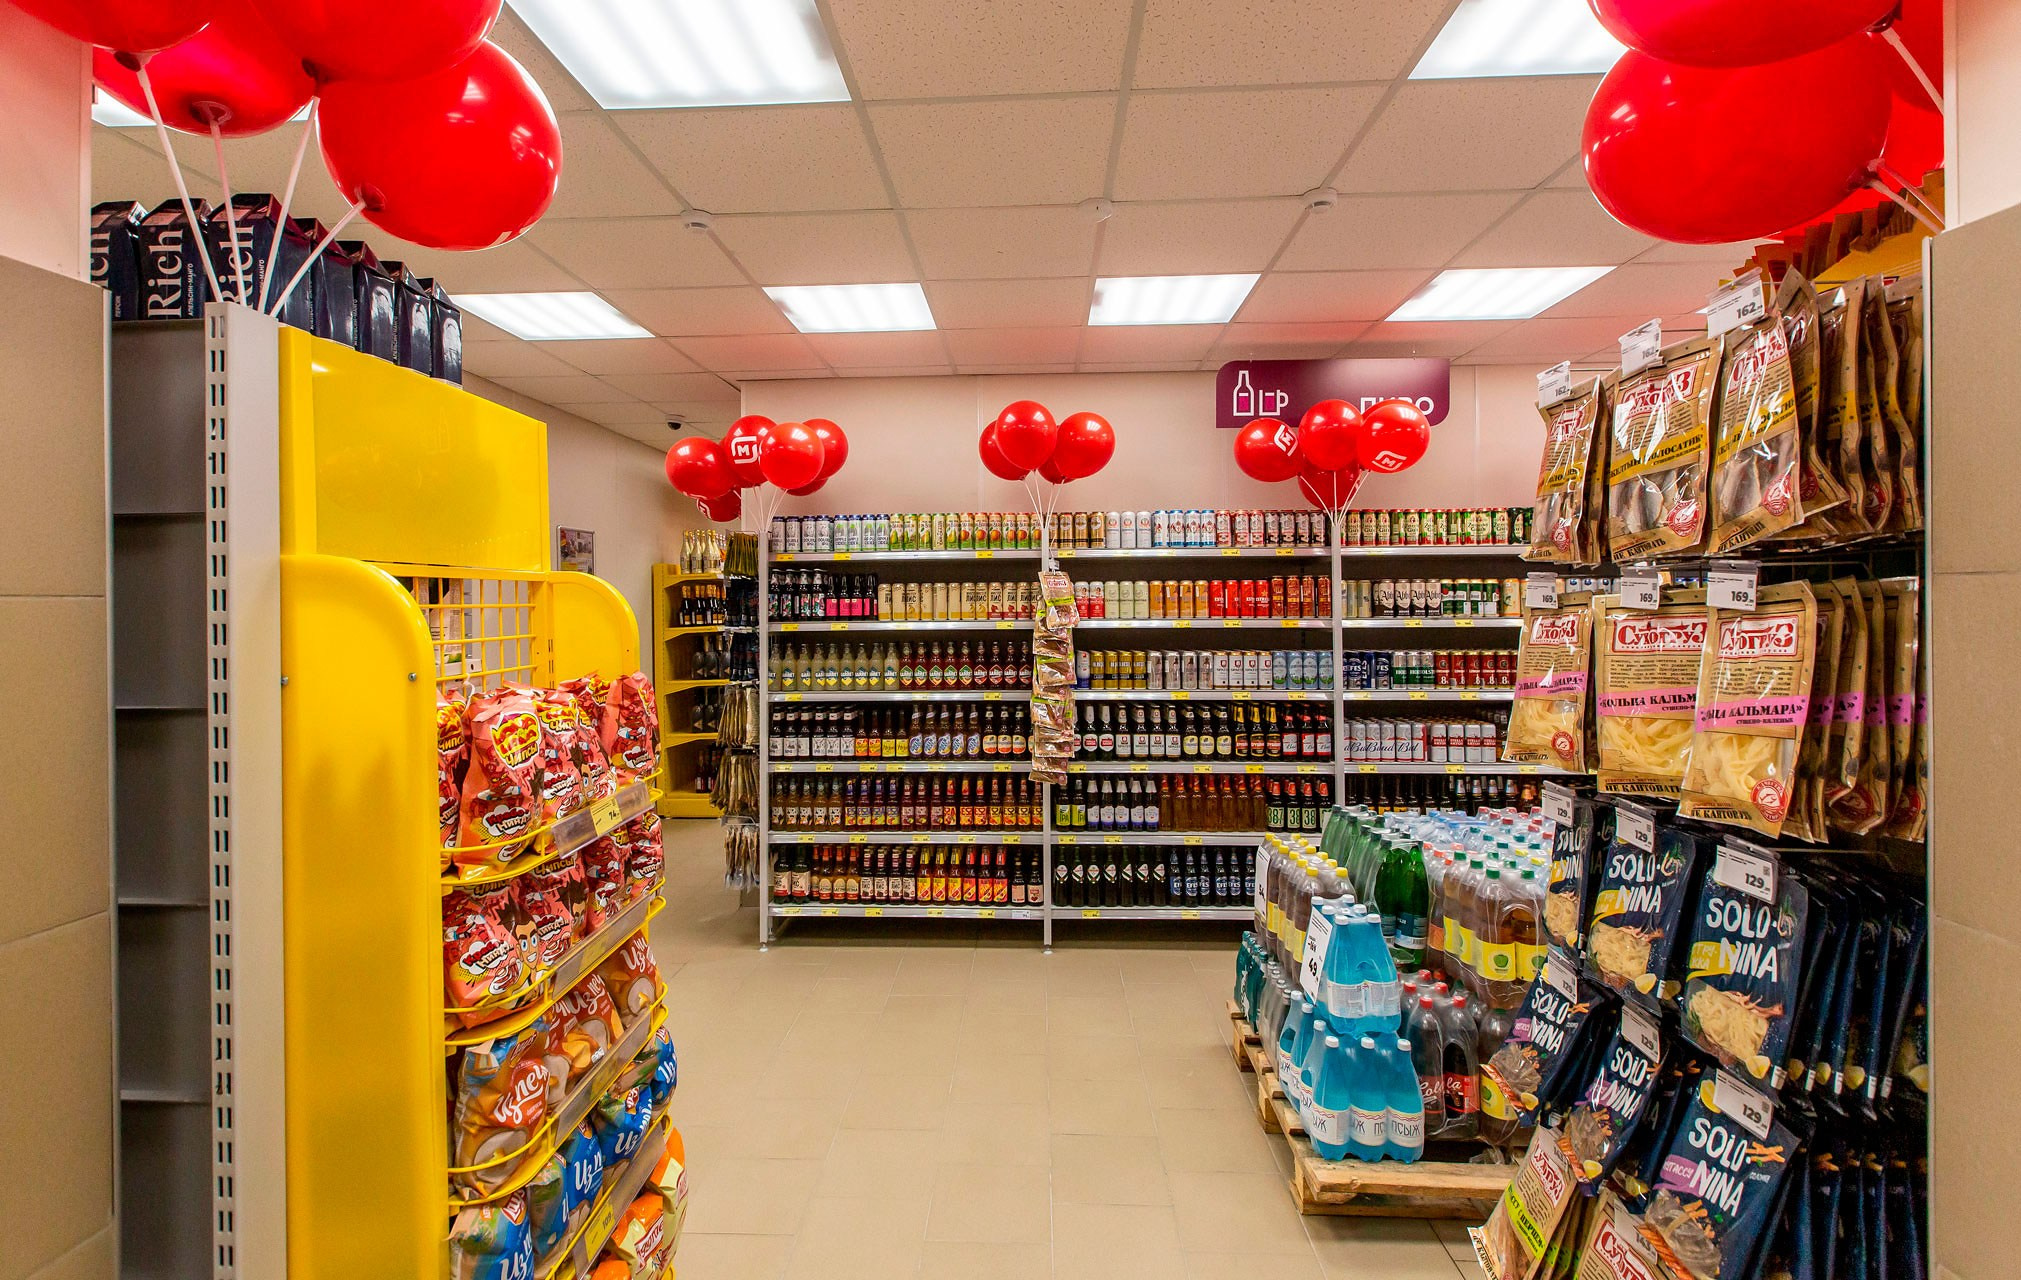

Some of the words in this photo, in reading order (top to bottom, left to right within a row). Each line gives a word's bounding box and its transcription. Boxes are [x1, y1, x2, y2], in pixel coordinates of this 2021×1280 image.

[148, 229, 183, 318] Rich
[1737, 302, 1757, 319] 162
[1360, 396, 1434, 416] ПО
[1542, 595, 1553, 603] 169
[1640, 593, 1653, 602] 169
[1732, 591, 1749, 602] 169
[1651, 693, 1696, 706] КАЛЬМ
[1289, 810, 1300, 824] 38
[1304, 810, 1315, 824] 38
[1557, 808, 1568, 818] 129
[1635, 830, 1648, 843] 129
[1745, 873, 1765, 889] 129
[1615, 885, 1662, 913] NINA
[1309, 957, 1318, 977] 49
[1718, 937, 1778, 982] NINA
[1528, 1016, 1565, 1055] NINA
[1641, 1034, 1654, 1050] 129
[1605, 1079, 1642, 1120] NINA
[1742, 1104, 1763, 1123] 129
[1392, 1120, 1421, 1136] ПСЫЖ
[1689, 1160, 1744, 1217] NINA
